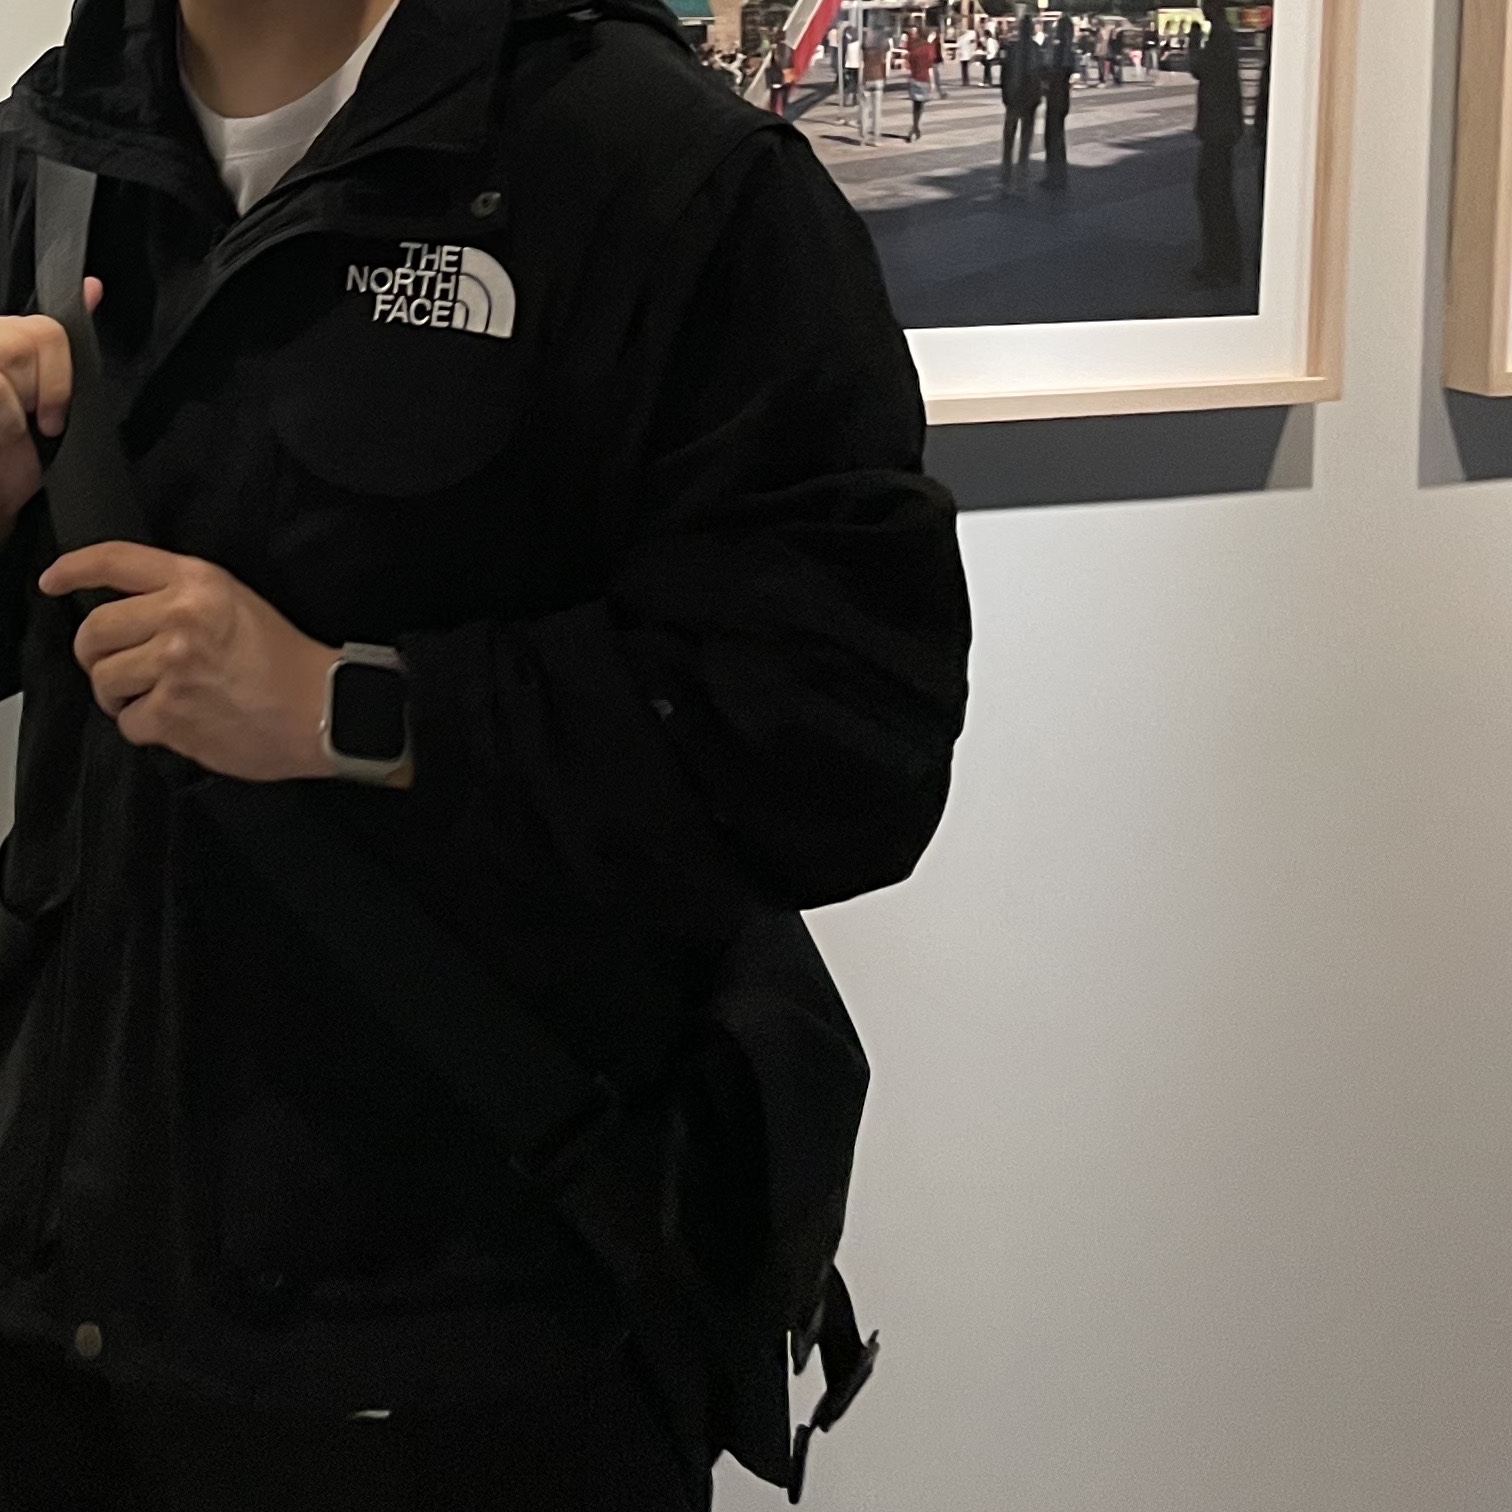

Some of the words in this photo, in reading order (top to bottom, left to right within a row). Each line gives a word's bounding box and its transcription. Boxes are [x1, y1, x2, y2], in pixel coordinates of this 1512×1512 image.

[399, 242, 462, 273] THE
[346, 264, 457, 300] NORTH
[372, 294, 453, 328] FACE
